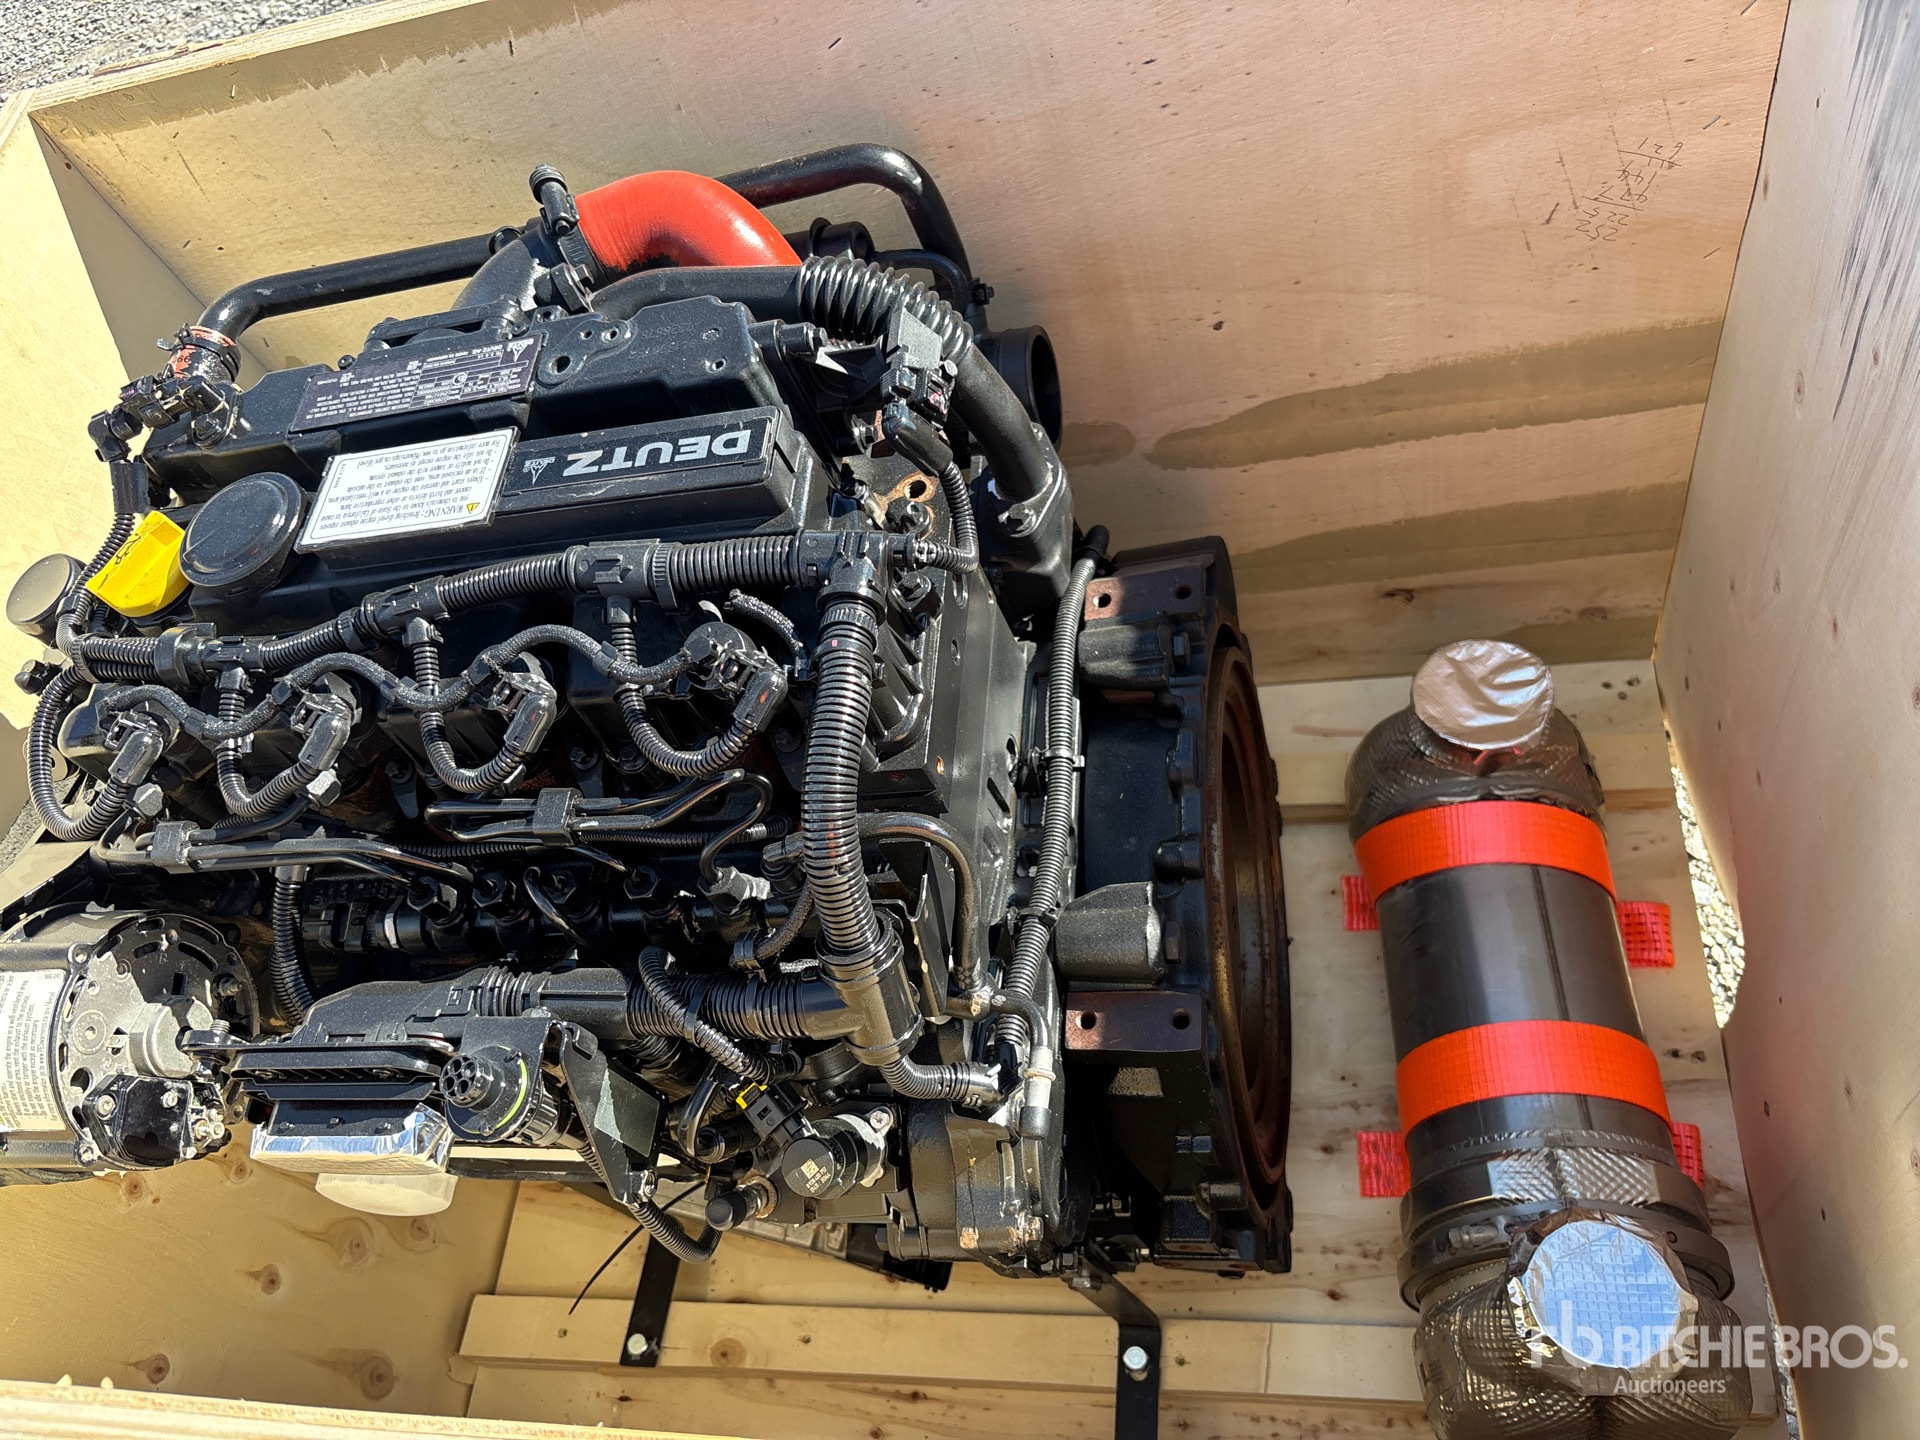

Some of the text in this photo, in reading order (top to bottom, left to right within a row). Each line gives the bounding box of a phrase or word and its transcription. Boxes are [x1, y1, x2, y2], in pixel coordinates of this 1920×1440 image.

[1582, 207, 1629, 226] 225
[1575, 219, 1618, 241] 252
[447, 443, 476, 452] information
[490, 439, 500, 447] For
[462, 451, 474, 459] idle
[562, 429, 752, 477] DEUTZ
[434, 454, 451, 462] engine
[525, 456, 556, 467] DEUTZ
[454, 460, 471, 469] modify
[387, 470, 405, 478] exhaust
[440, 470, 463, 479] enclosed
[383, 479, 402, 487] exhaust
[466, 475, 483, 483] Always
[420, 481, 439, 489] operate
[439, 480, 450, 488] and
[339, 491, 379, 502] well-ventilated
[408, 492, 427, 500] defects
[428, 490, 443, 498] birth
[352, 499, 384, 508] reproductive
[425, 498, 450, 507] chemicals
[342, 509, 369, 518] California
[377, 506, 391, 514] State
[394, 510, 420, 519] Breathing
[421, 505, 463, 517] WARNING:
[339, 519, 359, 527] exhaust
[359, 516, 376, 524] engine
[376, 514, 394, 523] diesel
